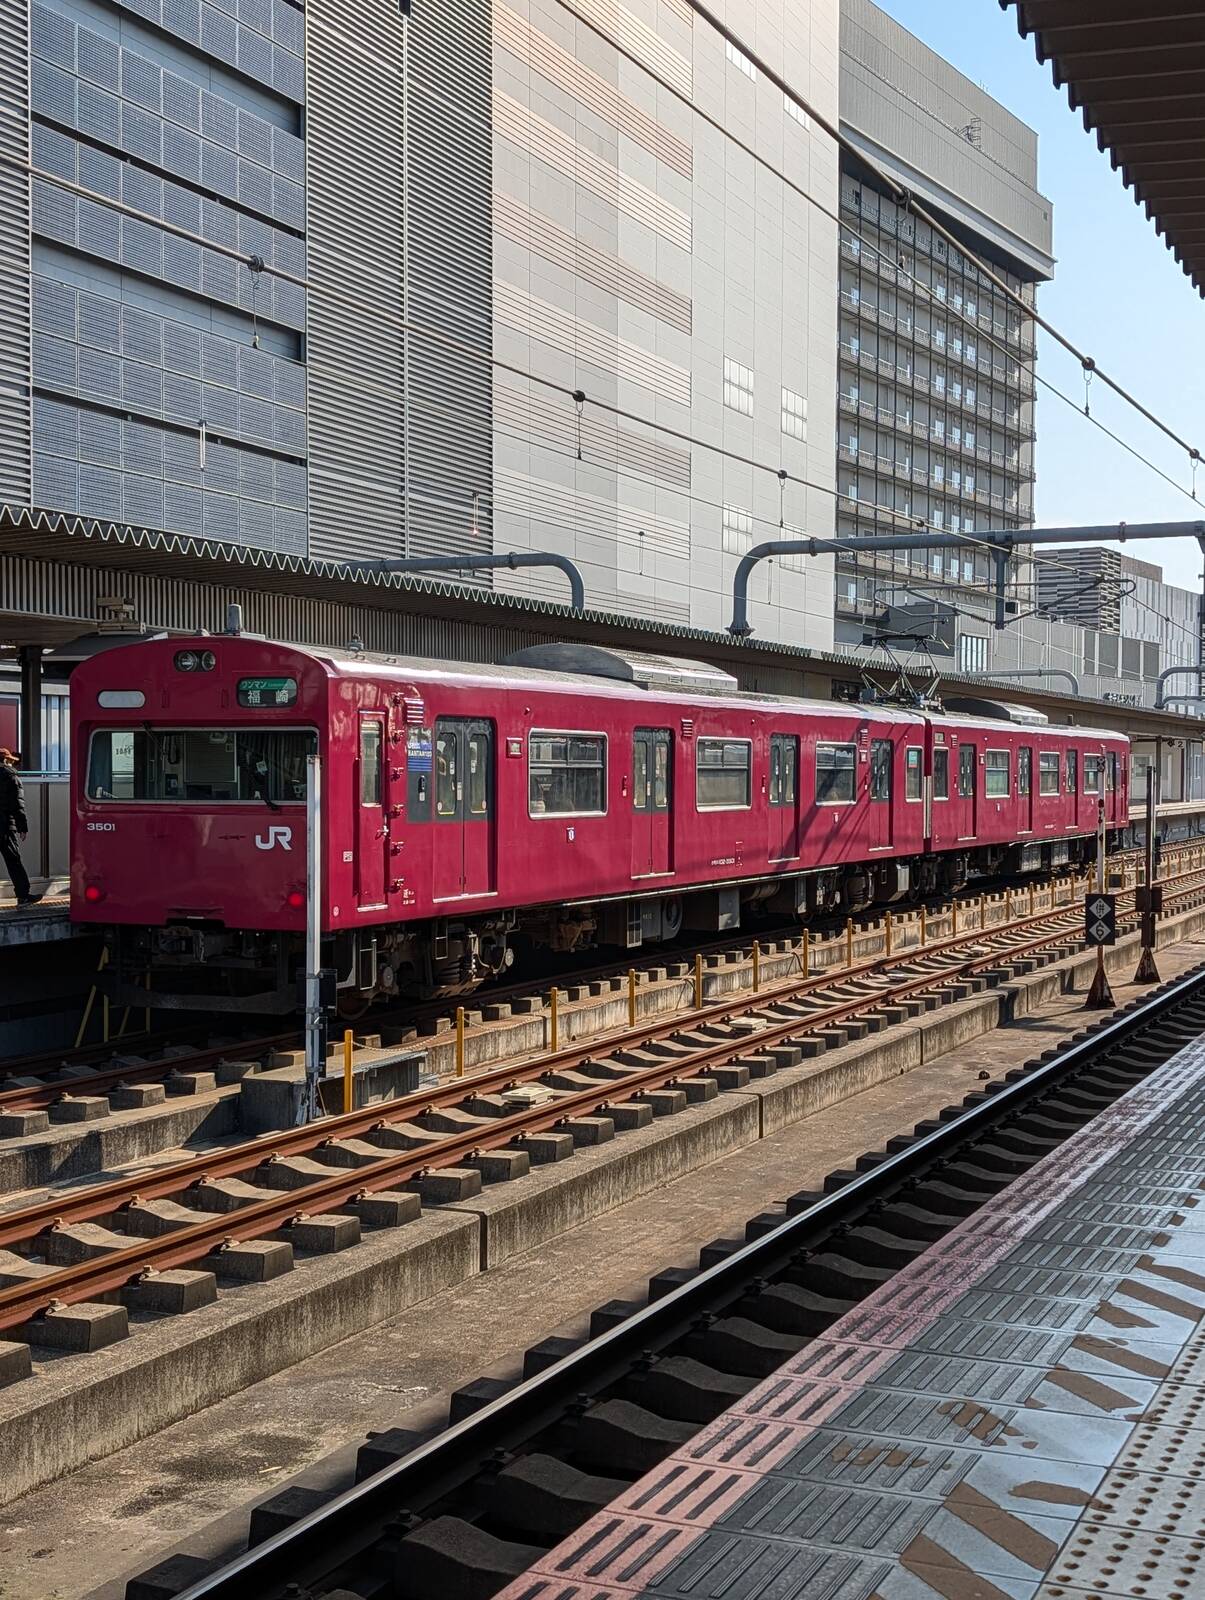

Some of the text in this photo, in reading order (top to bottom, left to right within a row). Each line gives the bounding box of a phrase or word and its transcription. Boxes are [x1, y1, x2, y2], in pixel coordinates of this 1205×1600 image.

[240, 680, 267, 689] ワンマン
[87, 822, 116, 831] 3501
[255, 826, 292, 850] JR
[1095, 924, 1105, 937] 6
